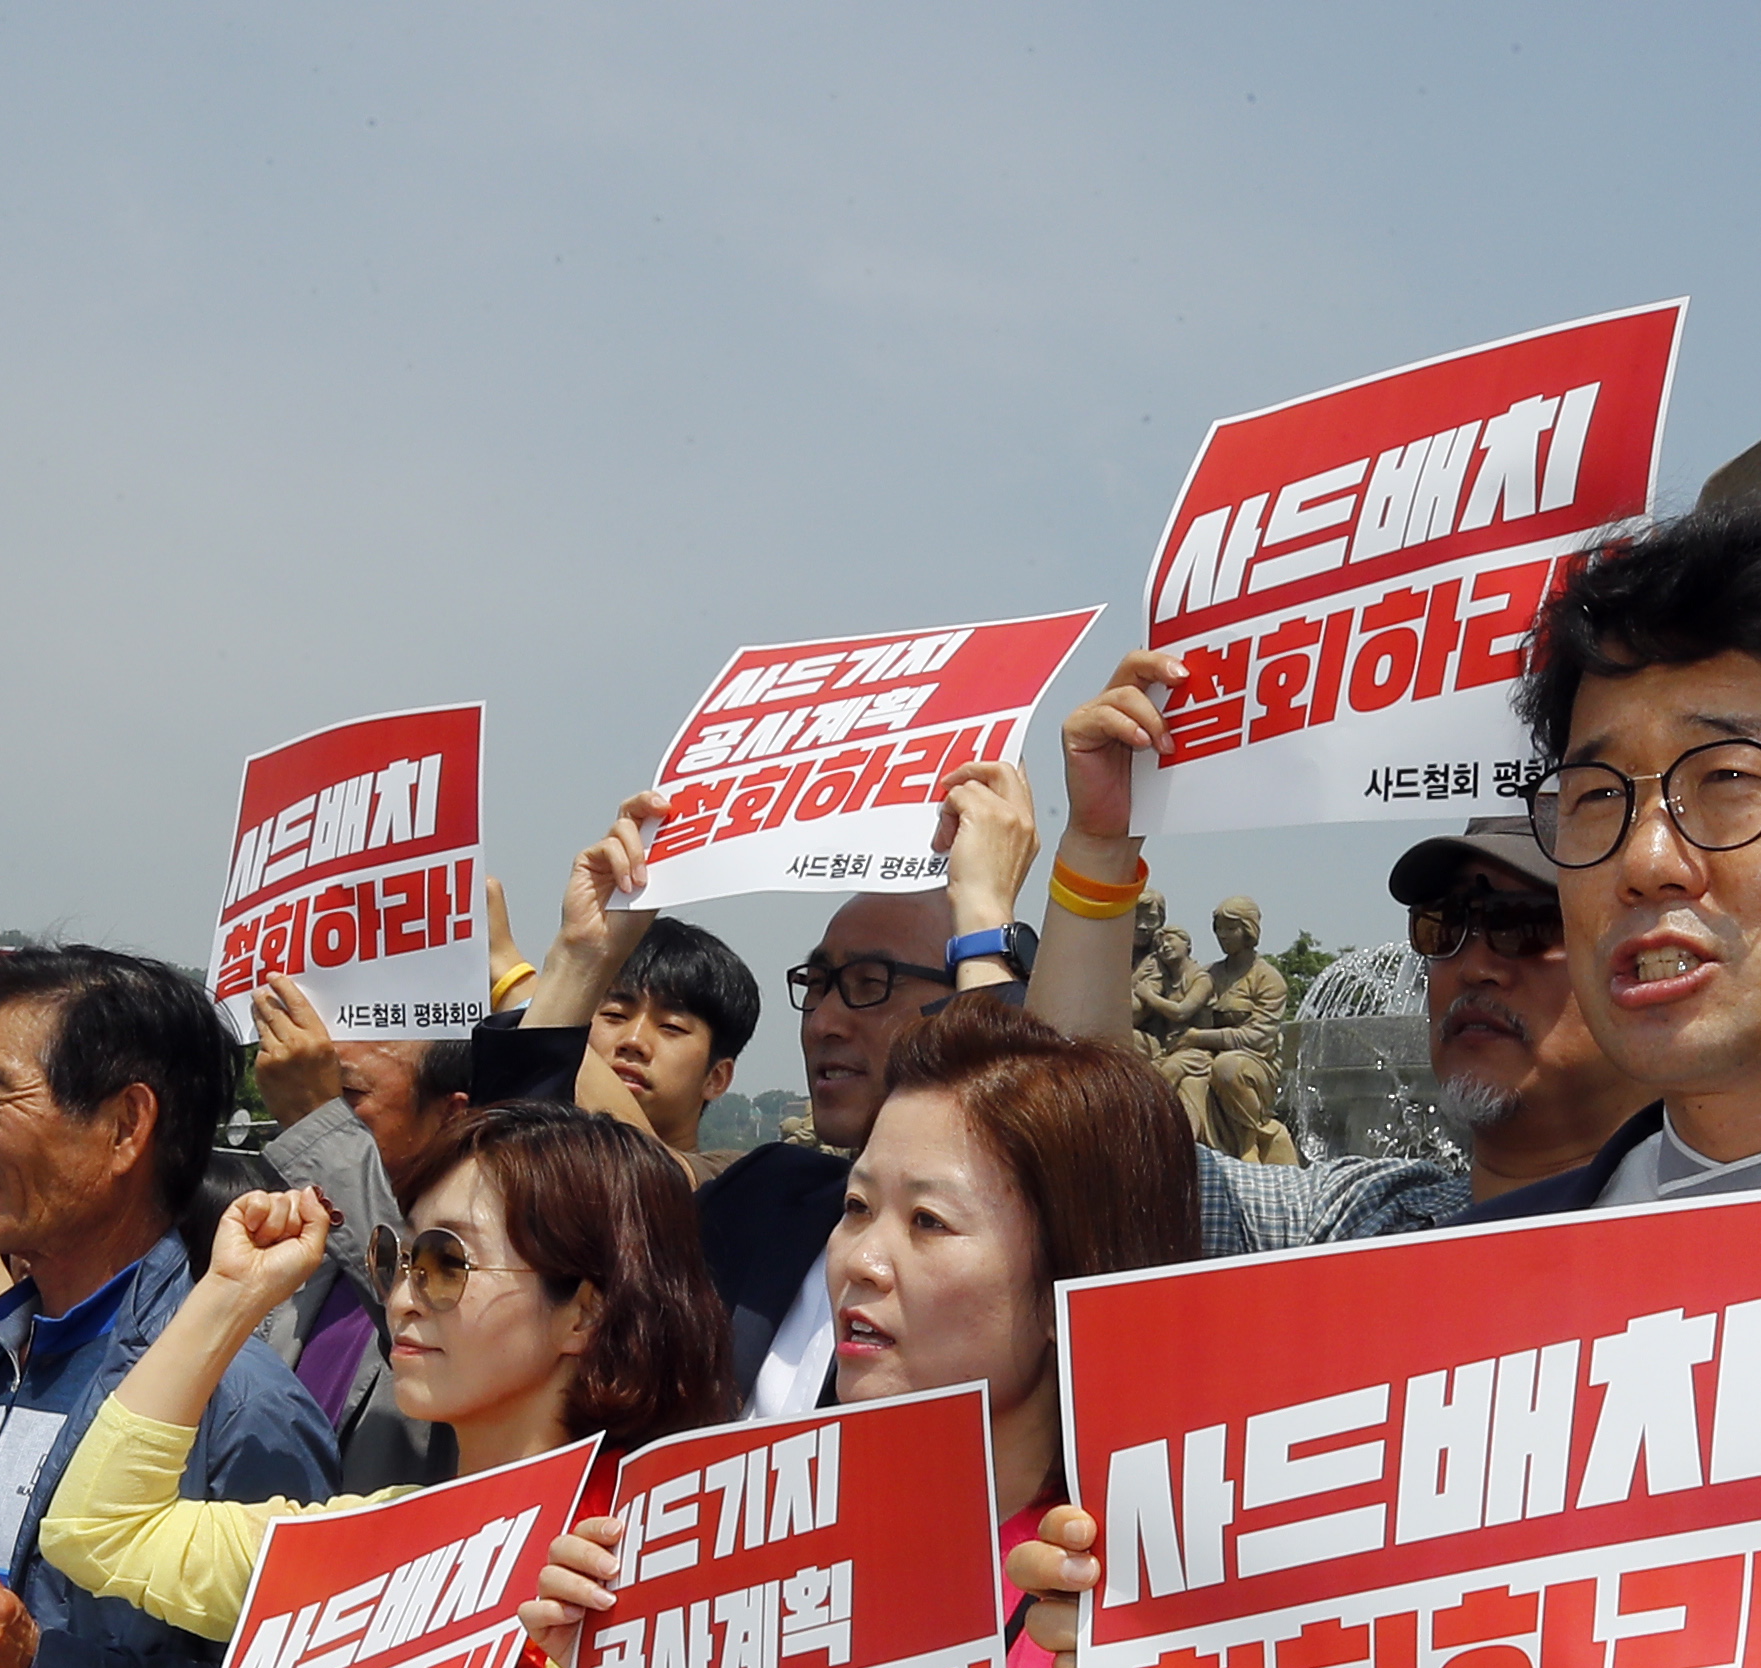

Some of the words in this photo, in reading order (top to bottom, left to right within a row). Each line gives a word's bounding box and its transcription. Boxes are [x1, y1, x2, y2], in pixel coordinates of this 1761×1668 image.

[1154, 381, 1602, 625] 사드배치
[703, 628, 975, 714] 사드기지
[1158, 545, 1570, 769] 철회하라
[675, 682, 940, 774] 공사계획
[1364, 761, 1479, 802] 사드철회
[225, 753, 443, 909] 사드배치
[646, 718, 1018, 865] 철회하라!
[787, 854, 872, 879] 사드철회
[880, 856, 948, 881] 평화회
[214, 857, 474, 1004] 철회하라!
[338, 1004, 406, 1028] 사드철회
[414, 1002, 484, 1028] 평화회의
